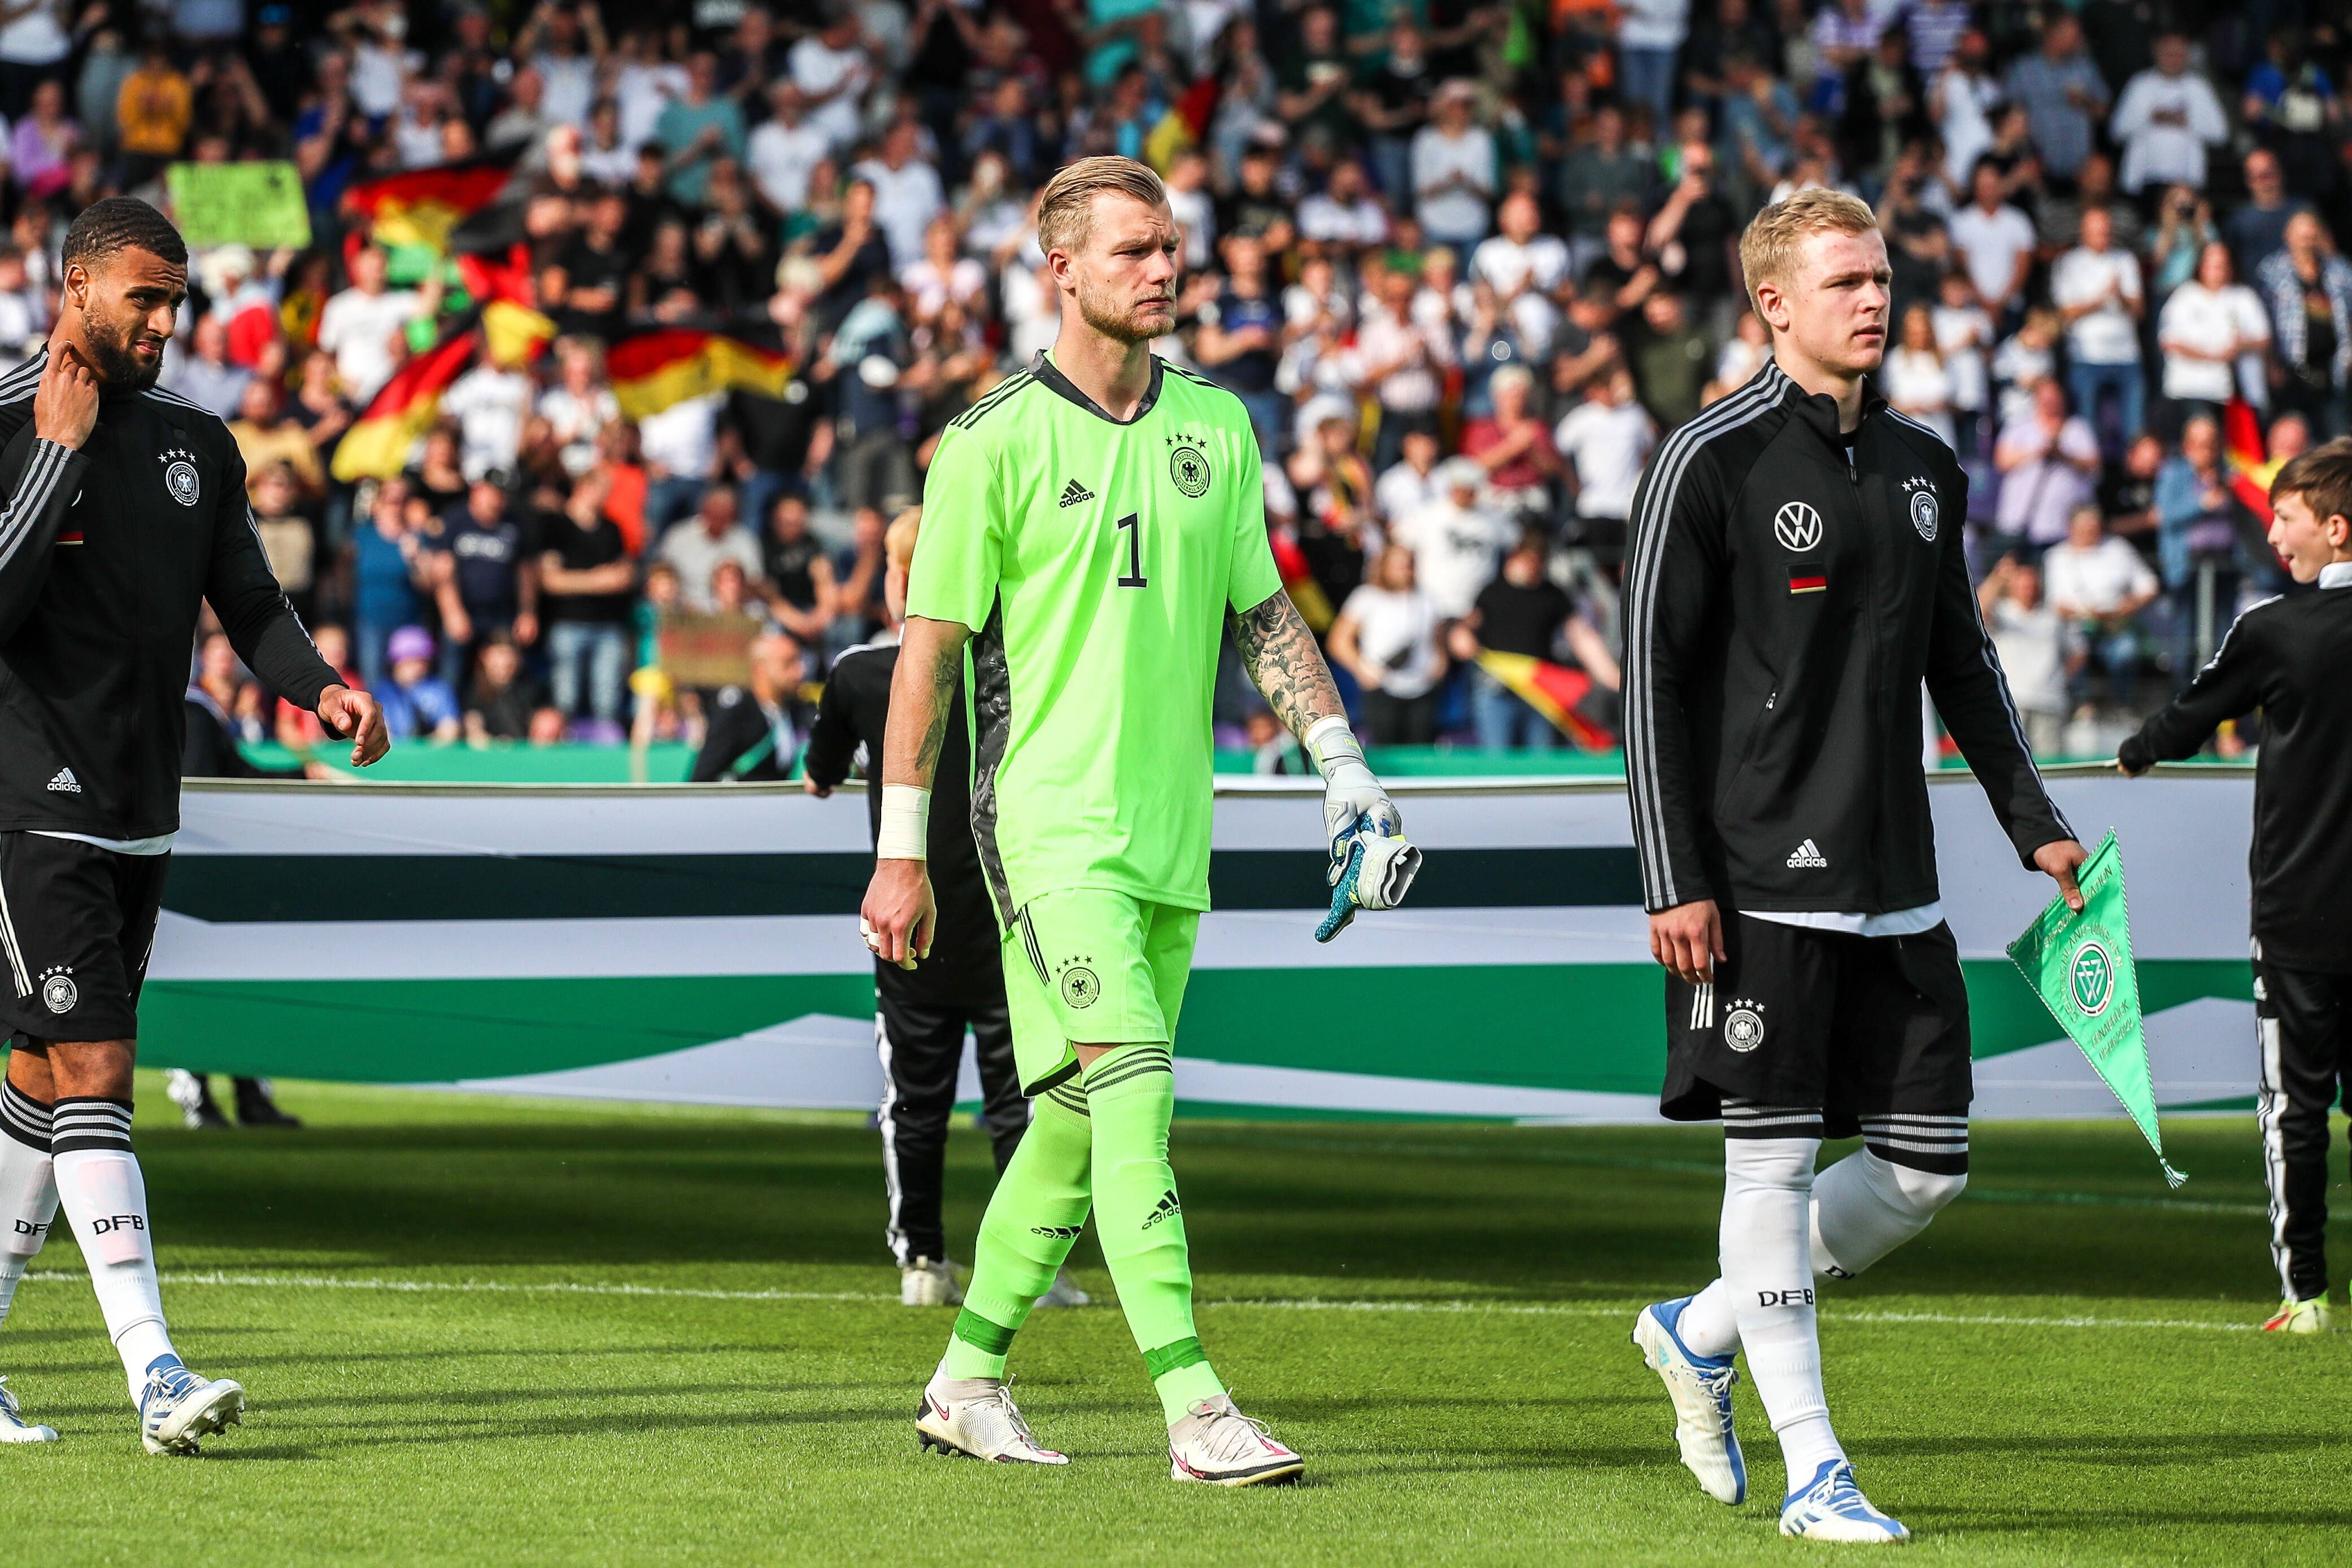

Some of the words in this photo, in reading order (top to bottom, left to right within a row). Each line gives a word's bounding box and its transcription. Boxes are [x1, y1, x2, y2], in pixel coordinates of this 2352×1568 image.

[1059, 491, 1095, 508] adidas
[1117, 511, 1148, 588] 1
[47, 781, 81, 793] adidas
[1786, 856, 1828, 869] adidas
[92, 1214, 145, 1235] DFB
[1142, 1205, 1181, 1230] adida
[1757, 1288, 1814, 1308] DFB
